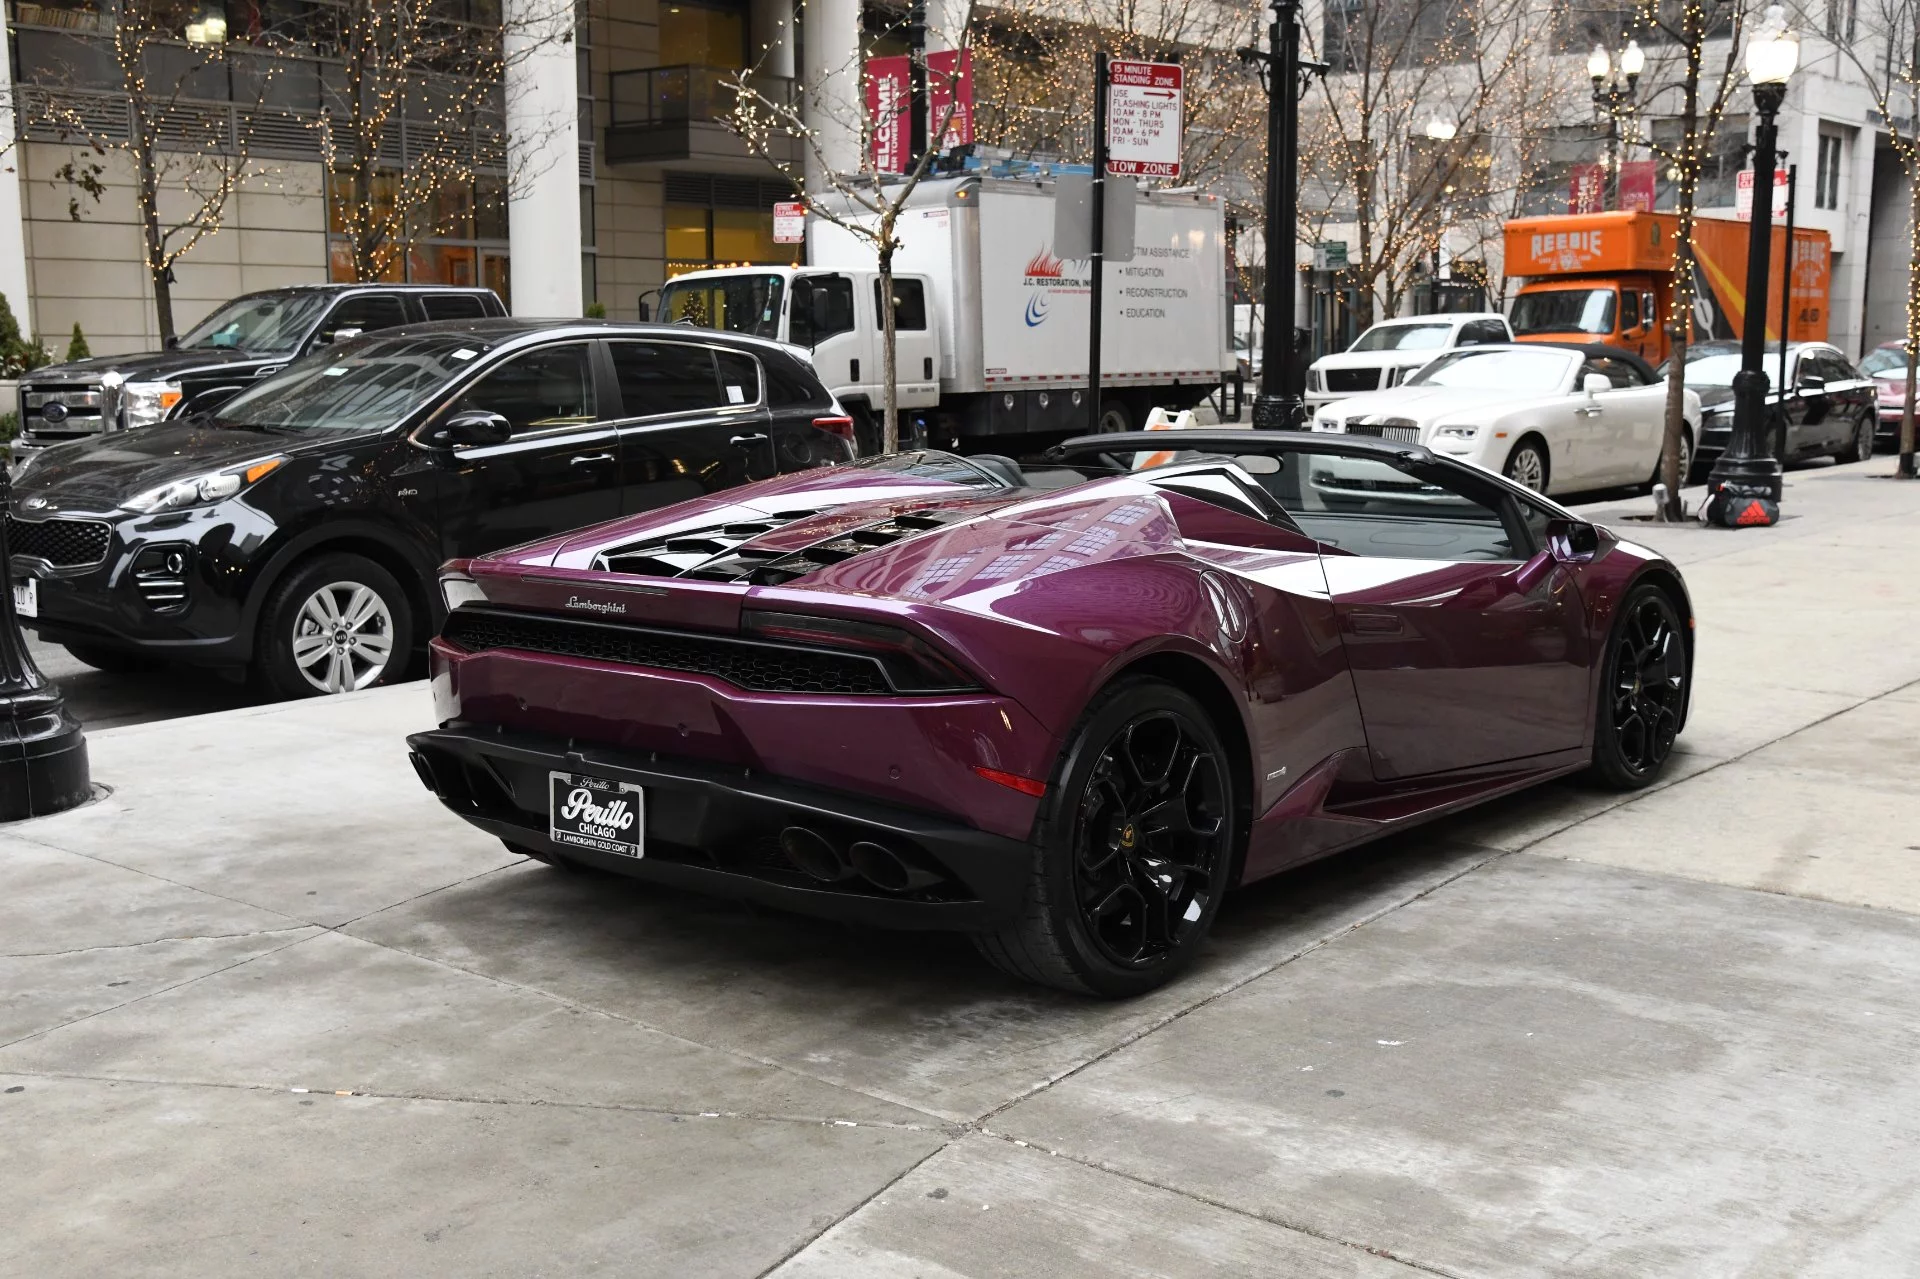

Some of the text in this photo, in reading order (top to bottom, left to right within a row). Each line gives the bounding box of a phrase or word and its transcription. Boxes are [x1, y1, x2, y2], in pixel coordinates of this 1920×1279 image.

[1113, 64, 1152, 76] 15 MINUTE
[1114, 75, 1174, 86] STANDING ZONE
[1113, 89, 1129, 98] USE
[1113, 99, 1178, 111] FLASHING LIGHTS
[1113, 108, 1121, 116] 10
[1123, 109, 1135, 117] AM
[1143, 110, 1148, 118] 8
[1113, 118, 1130, 126] MON
[1139, 119, 1164, 129] THURS
[1112, 127, 1120, 135] 10
[1122, 127, 1133, 135] AM
[1148, 129, 1160, 137] PM
[1112, 137, 1125, 145] FRI
[1132, 137, 1149, 146] SUN
[1112, 161, 1173, 175] TOW ZONE
[1531, 230, 1603, 260] REEBIE
[1149, 247, 1190, 259] ASSISTANCE
[1125, 267, 1164, 277] MITIGATION
[1023, 278, 1035, 286] J.C.
[1037, 278, 1081, 288] RESTORATION,
[1126, 288, 1188, 298] RECONSTRUCTION
[1126, 308, 1165, 318] EDUCATION
[565, 596, 627, 614] Lamborghini
[580, 777, 610, 790] Perillo
[561, 788, 634, 830] Perillo
[579, 822, 616, 839] CHICAGO
[563, 833, 628, 853] LAMBORGHINI GOLD COAST
